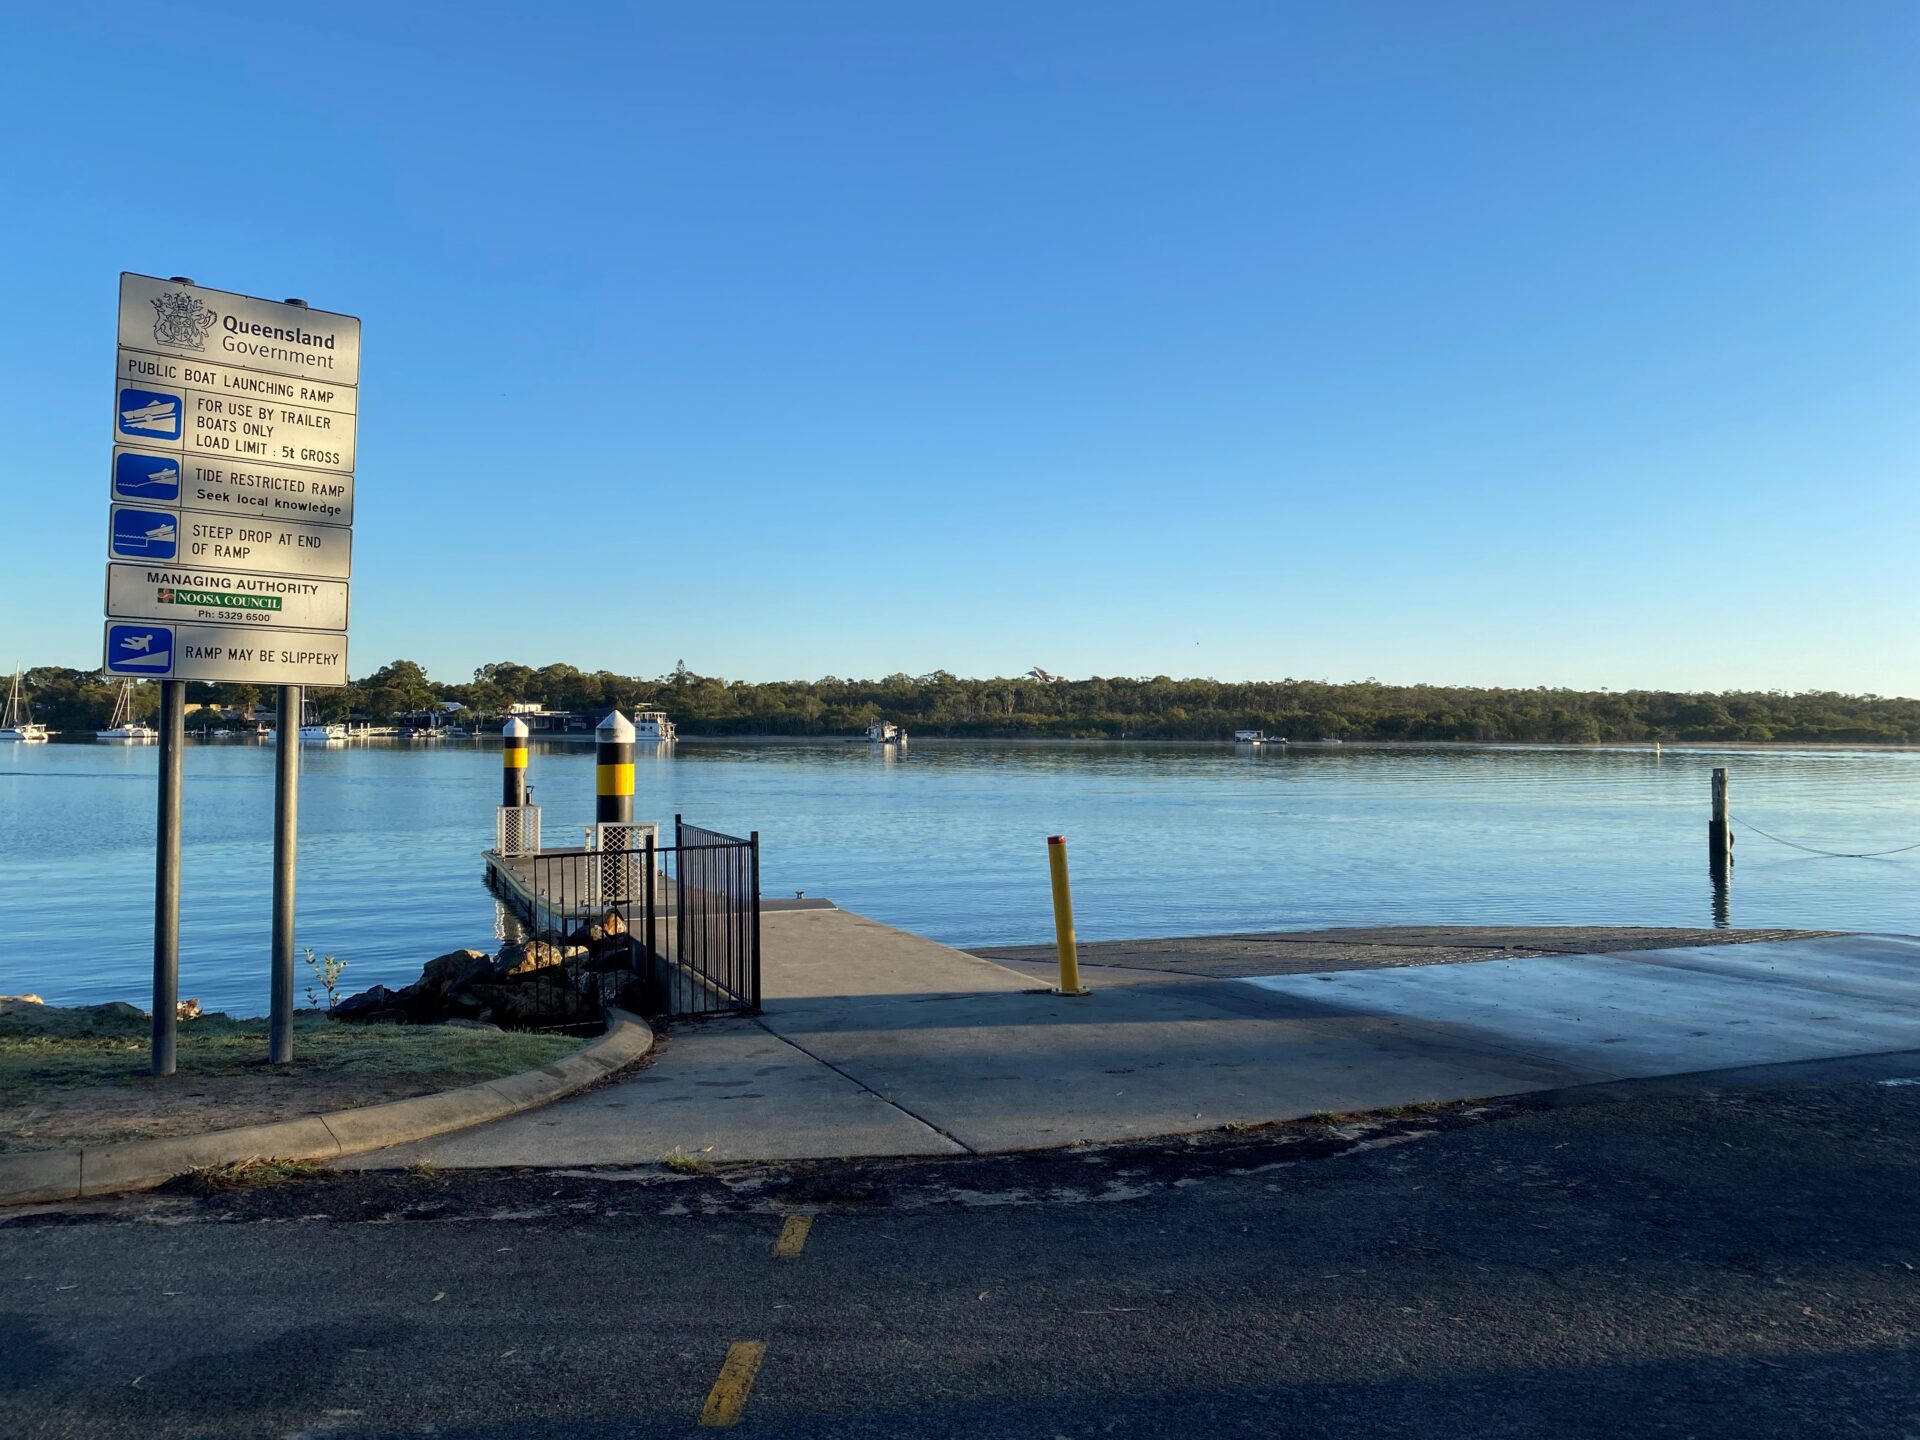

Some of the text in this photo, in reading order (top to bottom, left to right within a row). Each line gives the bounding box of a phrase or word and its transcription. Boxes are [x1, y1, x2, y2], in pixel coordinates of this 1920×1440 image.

[223, 315, 335, 349] Queensland
[223, 336, 334, 369] Government
[129, 360, 334, 403] PUBLIC BOAT LAUNCHING RAMP
[198, 398, 331, 429] FOR USE BY TRAILER
[197, 417, 274, 437] BOATS ONLY
[197, 434, 229, 449] LOAD
[236, 440, 267, 456] LIMIT
[282, 446, 294, 458] 5t
[301, 450, 340, 464] GROSS
[195, 468, 345, 497] TIDE RESTRICTED RAMP
[197, 489, 341, 516] Seek local knowledge
[193, 525, 321, 548] STEEP DROP AT END
[192, 543, 250, 558] OF RAMP
[147, 573, 318, 595] MANAGING AUTHORITY
[178, 592, 280, 609] NOOSA COUNCIL
[198, 610, 270, 622] Ph: 5329 6500
[185, 646, 338, 665] RAMP MAY BE SLIPPERY
